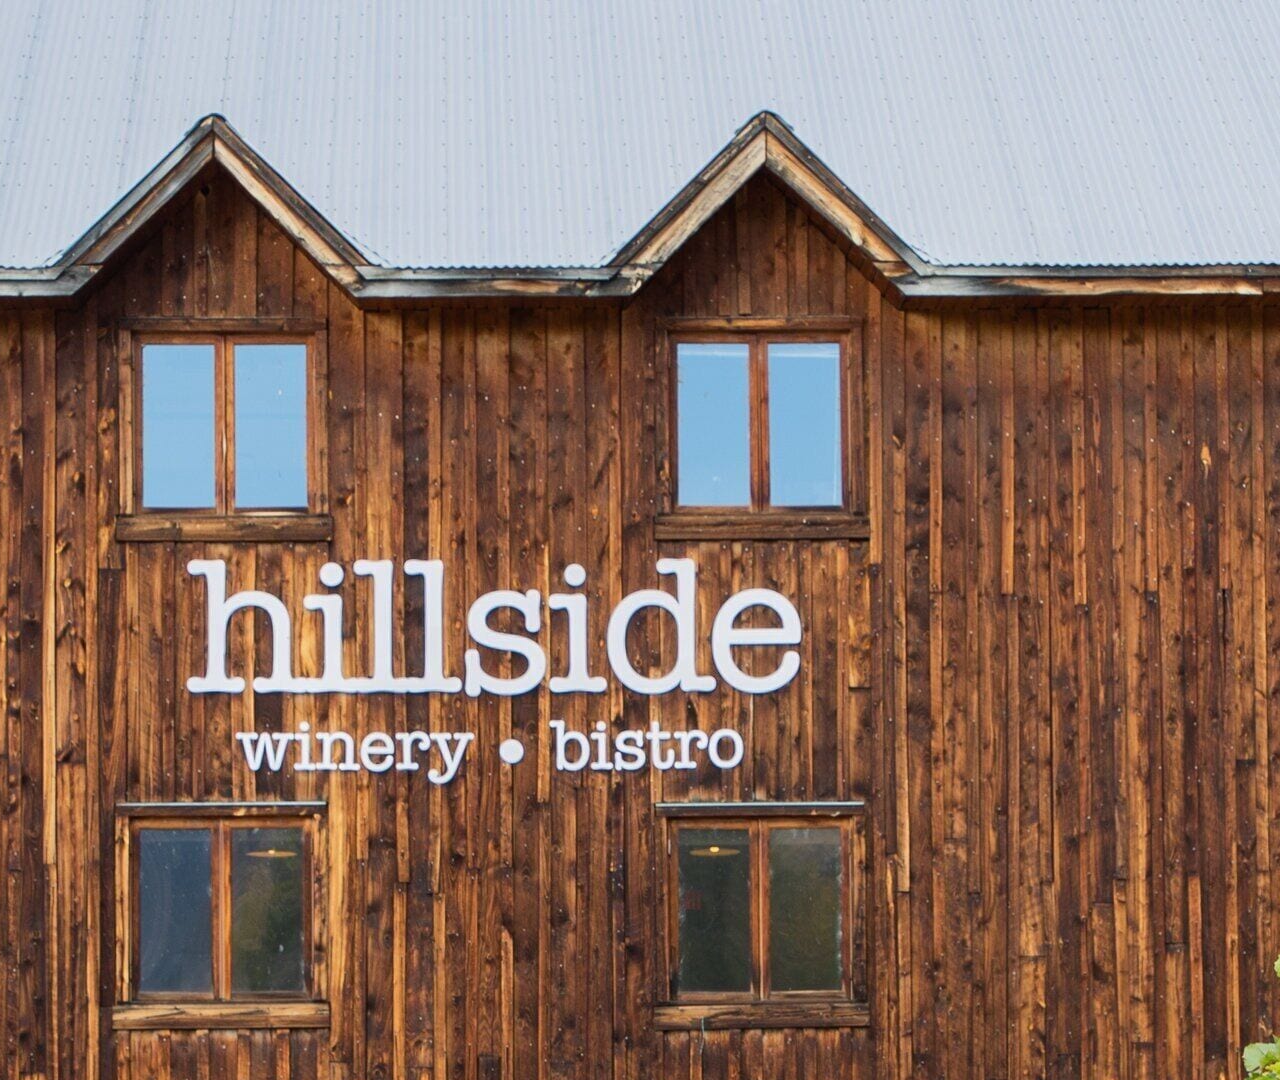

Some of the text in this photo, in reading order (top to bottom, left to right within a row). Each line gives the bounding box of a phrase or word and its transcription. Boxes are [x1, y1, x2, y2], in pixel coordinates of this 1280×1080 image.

[185, 557, 803, 697] hillside
[234, 719, 745, 786] winery bistro
